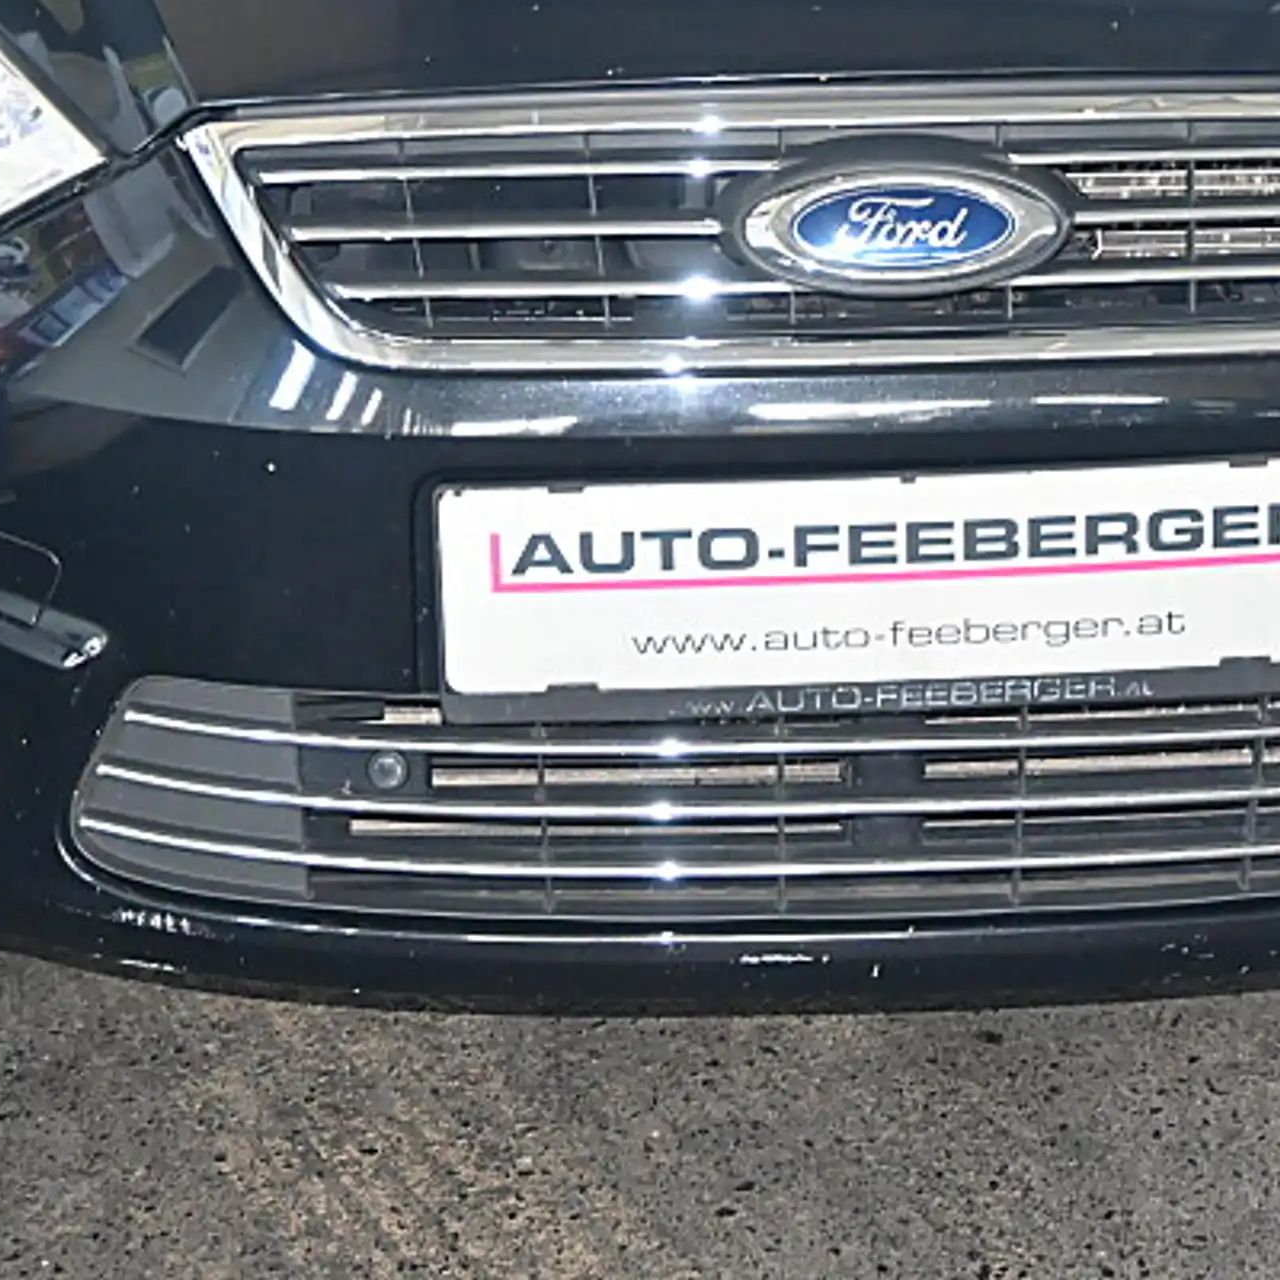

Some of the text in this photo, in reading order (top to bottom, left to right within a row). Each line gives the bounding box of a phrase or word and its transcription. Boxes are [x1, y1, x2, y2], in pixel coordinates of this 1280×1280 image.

[833, 197, 969, 250] Ford
[631, 610, 1186, 656] www.auto-feeberger.at
[670, 676, 1154, 715] ww.AUTO-FEEBERGER.at
